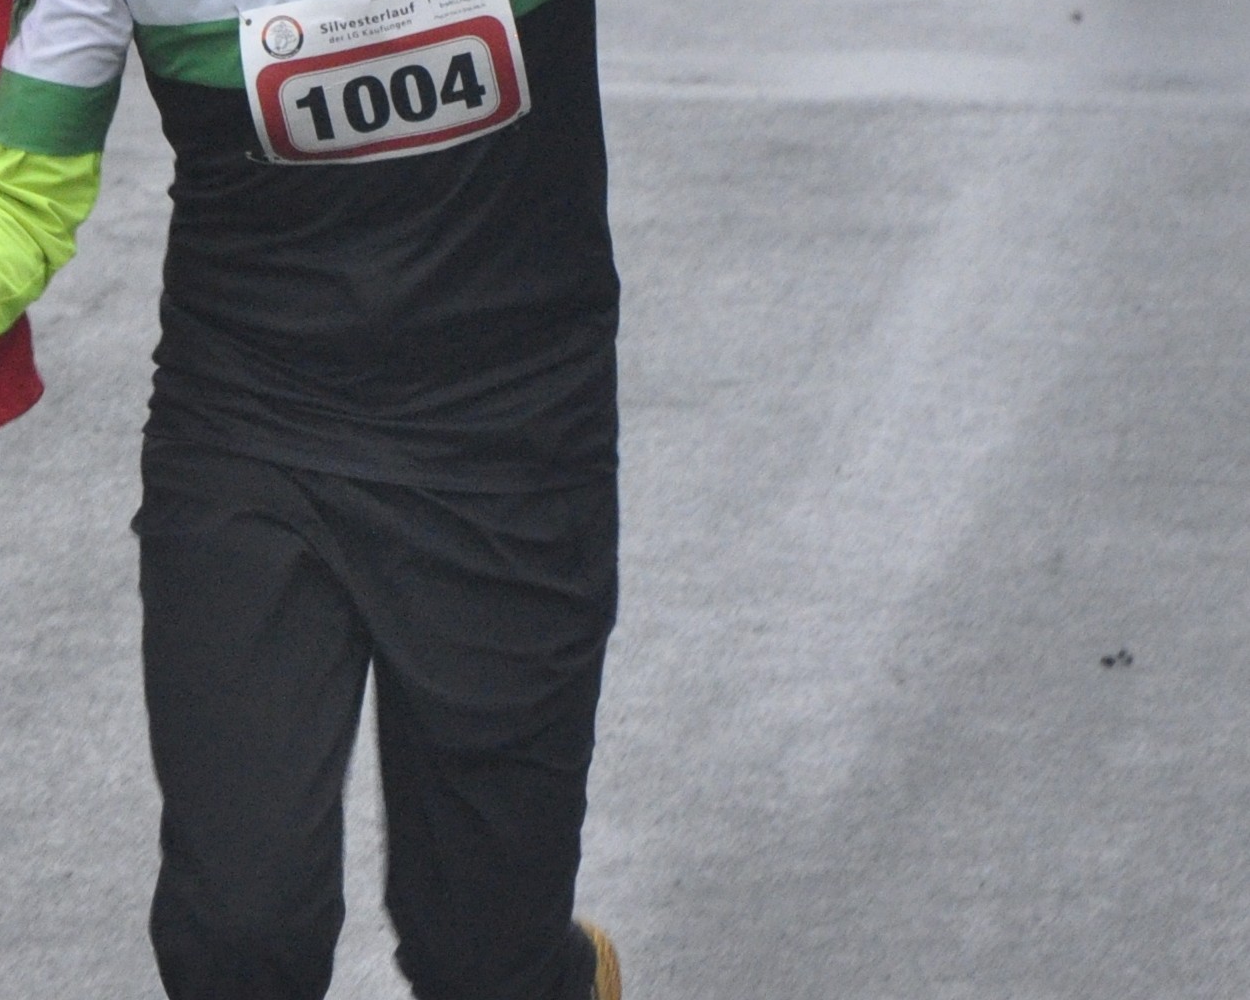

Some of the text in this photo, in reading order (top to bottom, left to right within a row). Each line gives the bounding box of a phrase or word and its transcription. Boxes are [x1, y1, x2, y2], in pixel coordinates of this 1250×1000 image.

[319, 1, 416, 35] Silvesterlauf
[329, 18, 413, 44] der LG Kaufungen
[295, 51, 486, 141] 1004
